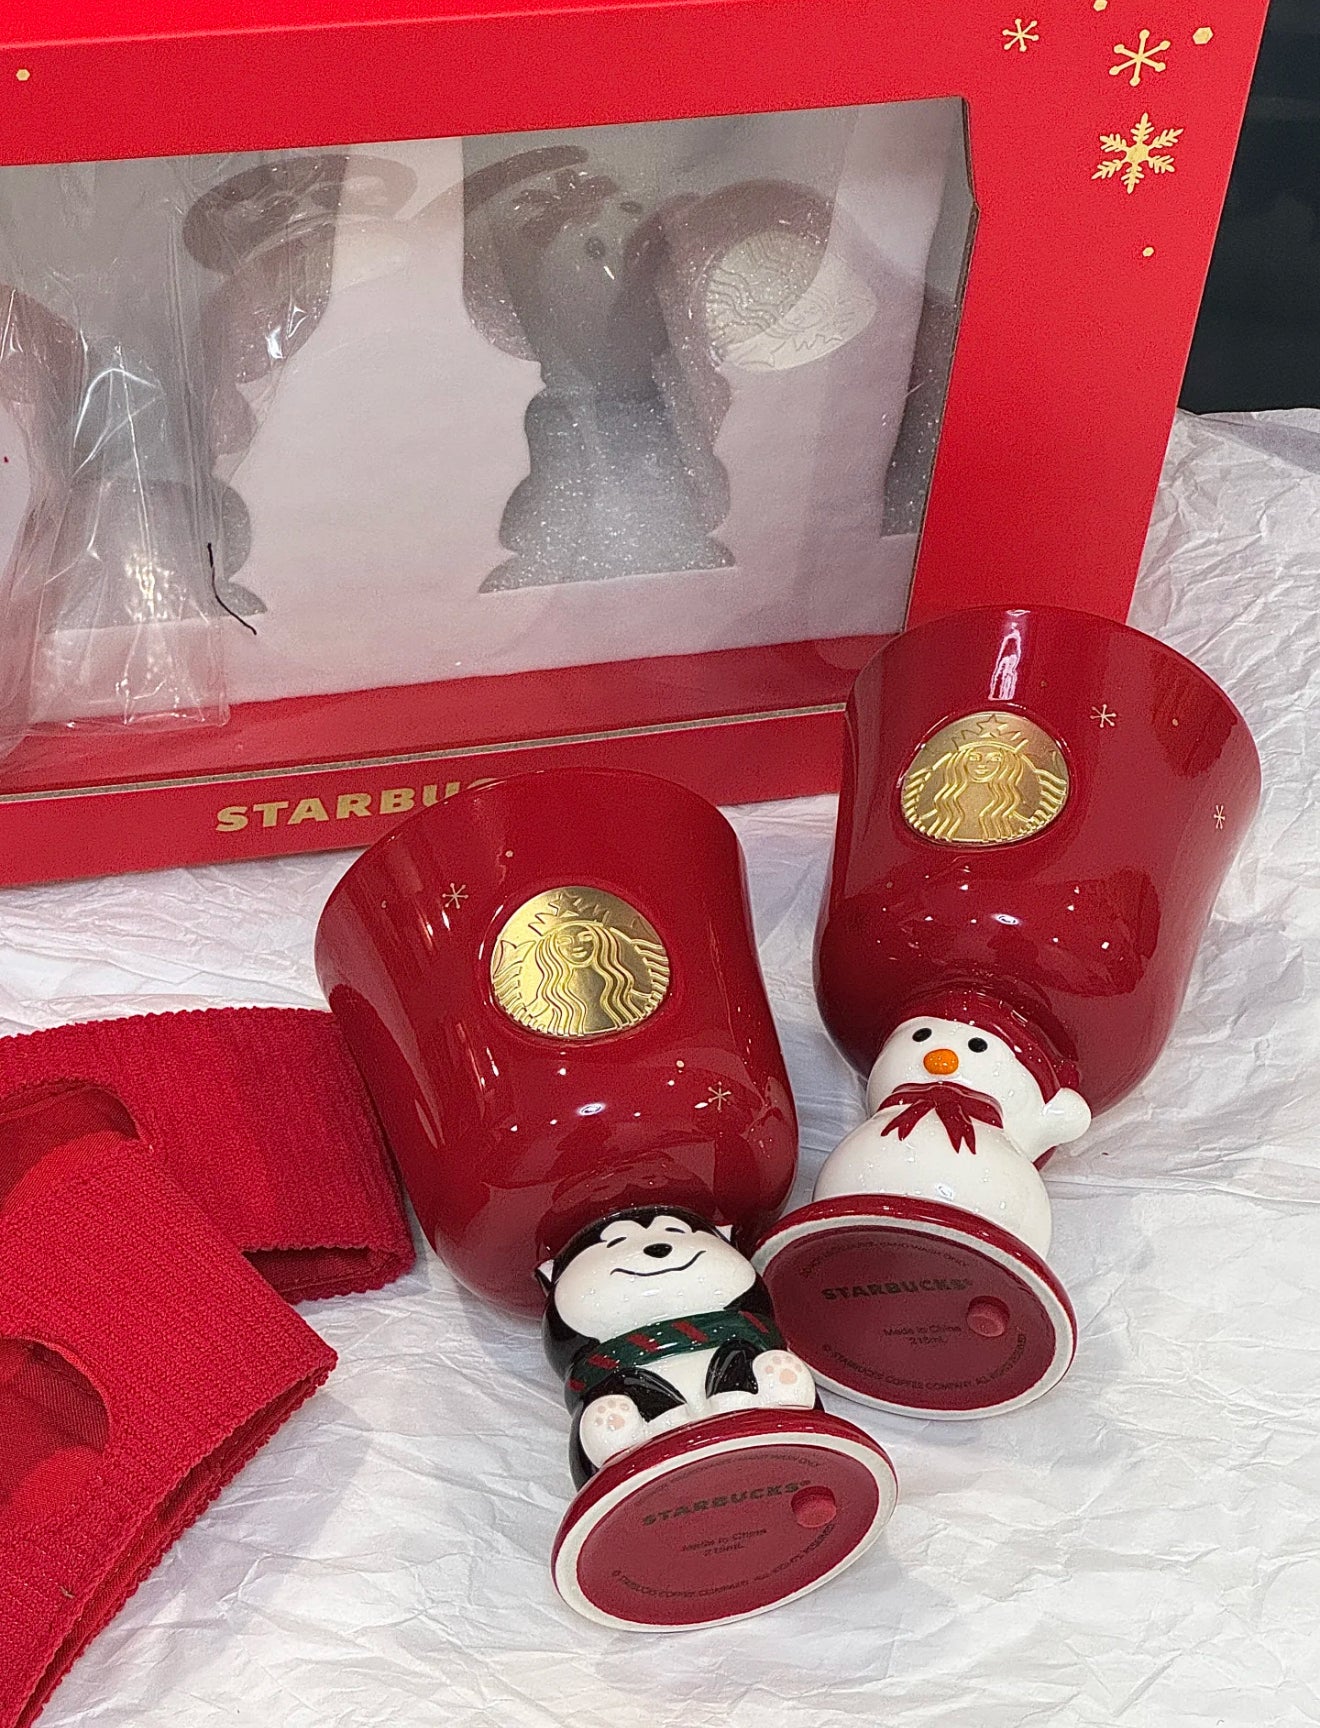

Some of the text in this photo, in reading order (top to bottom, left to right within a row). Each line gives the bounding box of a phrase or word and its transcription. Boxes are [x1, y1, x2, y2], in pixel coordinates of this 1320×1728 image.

[215, 777, 501, 832] STARBU
[883, 1326, 915, 1337] Made
[929, 1323, 963, 1334] China
